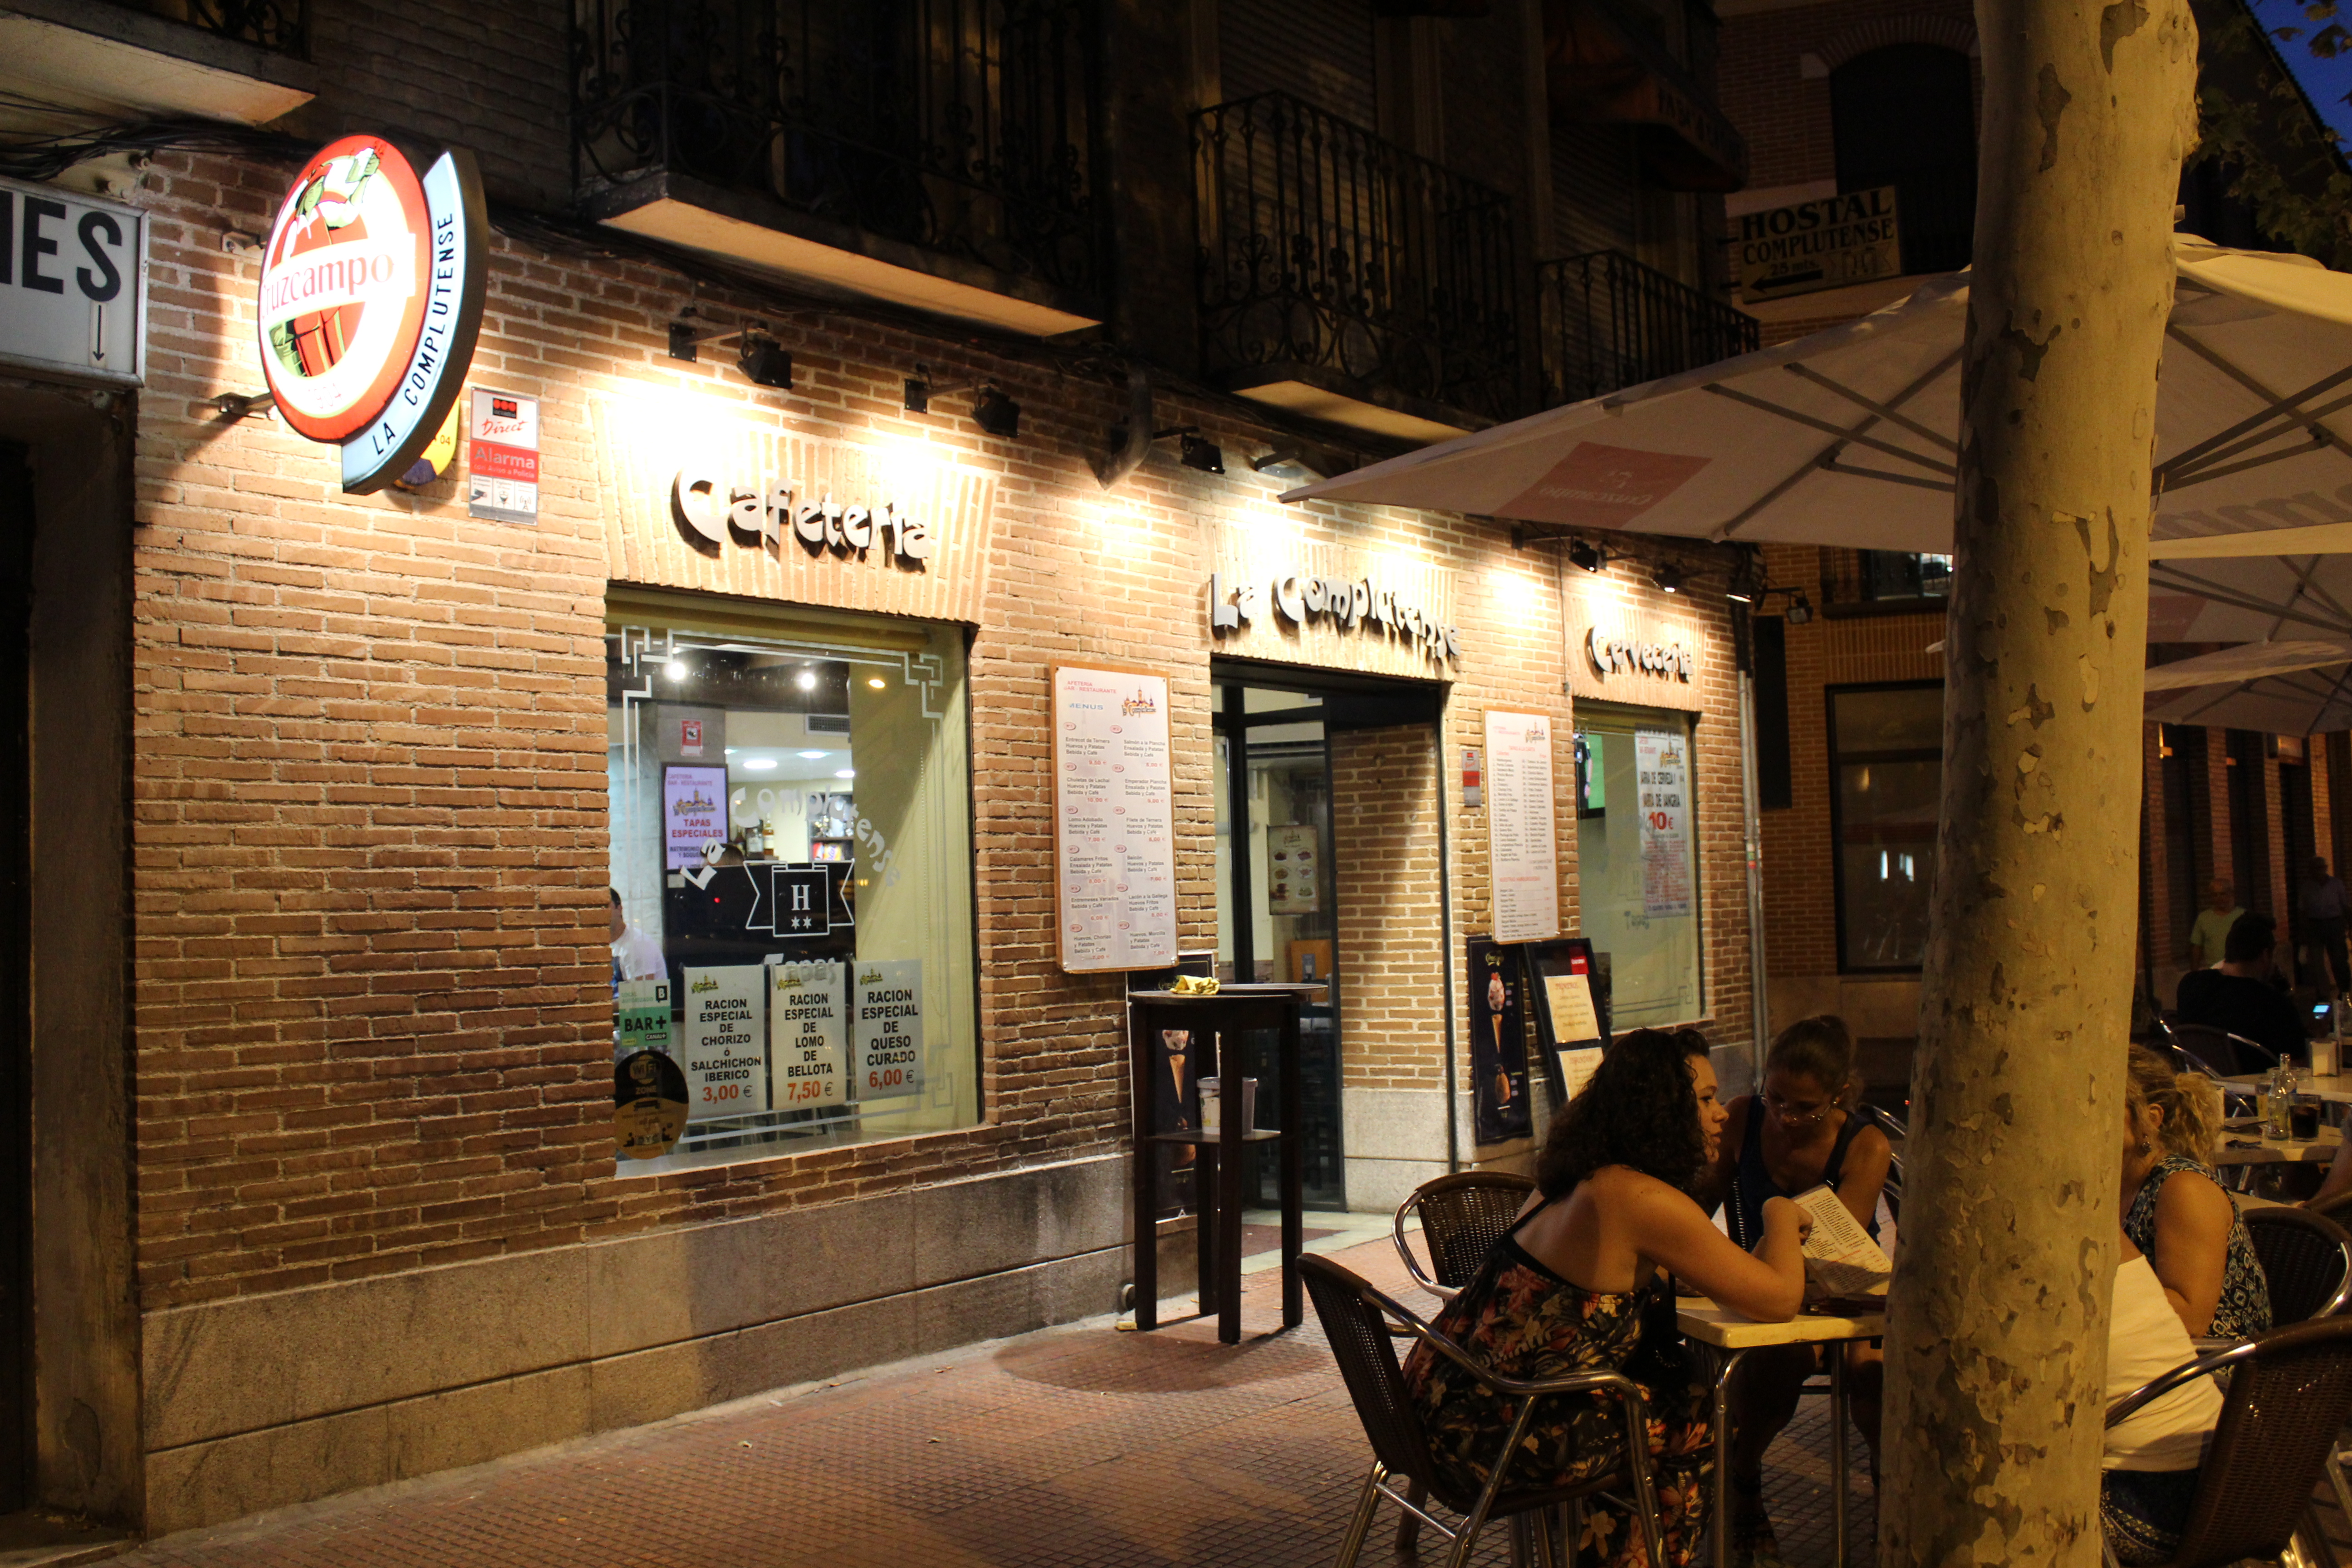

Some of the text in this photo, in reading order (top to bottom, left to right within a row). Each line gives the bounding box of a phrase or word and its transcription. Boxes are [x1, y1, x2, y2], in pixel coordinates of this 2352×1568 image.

[1741, 190, 1892, 240] HOSTAL
[1743, 218, 1895, 265] COMPLUTENSE
[262, 254, 395, 319] ruzcampo
[372, 213, 453, 456] LA COMPLUTENSE
[308, 382, 343, 409] 904
[481, 417, 529, 436] Direct
[474, 446, 535, 470] Alarma
[1211, 564, 1460, 659] La Complutense
[1649, 812, 1674, 830] 10 €
[680, 786, 901, 891] La Complutense
[791, 884, 810, 911] H
[657, 987, 665, 999] B
[789, 993, 828, 1005] RACION
[867, 989, 912, 1003] RACION
[706, 999, 747, 1009] RACION
[862, 1004, 918, 1019] ESPECIAL
[700, 1010, 752, 1022] ESPECIAL
[784, 1008, 833, 1020] ESPECIAL
[720, 1023, 733, 1033] DE
[803, 1022, 816, 1033] DE
[883, 1021, 898, 1033] DE
[701, 1034, 751, 1046] CHORIZO
[795, 1035, 824, 1048] LOMO
[871, 1035, 911, 1050] QUESO
[804, 1050, 817, 1062] DE
[867, 1050, 916, 1066] CURADO
[691, 1057, 761, 1071] SALCHICHON
[788, 1063, 833, 1077] BELLOTA
[705, 1070, 750, 1082] IBERICO
[869, 1068, 914, 1090] 6,00 €
[703, 1084, 753, 1104] 3,00 €
[788, 1080, 833, 1103] 7,50 €
